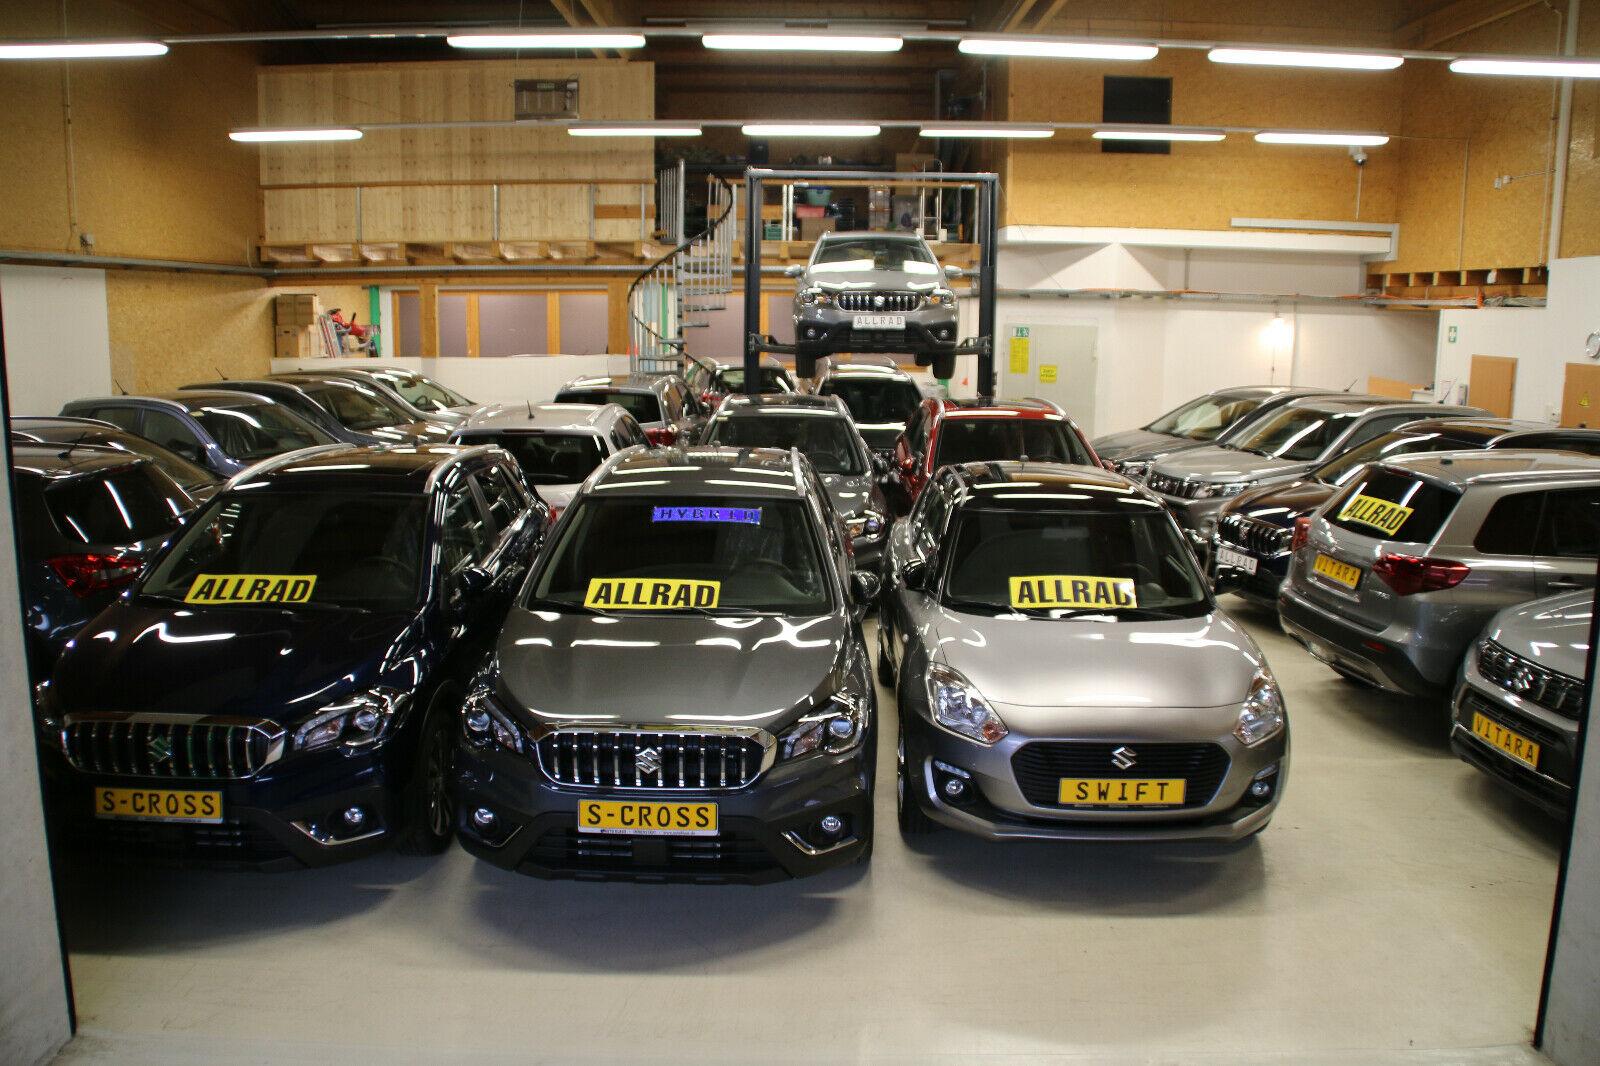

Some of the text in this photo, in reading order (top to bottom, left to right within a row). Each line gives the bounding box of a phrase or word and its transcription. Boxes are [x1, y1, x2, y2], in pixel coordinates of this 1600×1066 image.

[856, 316, 902, 325] ALLRAD
[1343, 498, 1407, 531] ALLRAD
[1318, 557, 1357, 584] VITARA
[191, 578, 311, 602] ALLRAD
[591, 582, 716, 607] ALLRAD
[1475, 715, 1534, 762] VITARA
[103, 791, 215, 816] S-CROSS
[1075, 781, 1170, 801] SWIFT
[587, 803, 710, 828] S-CROSS
